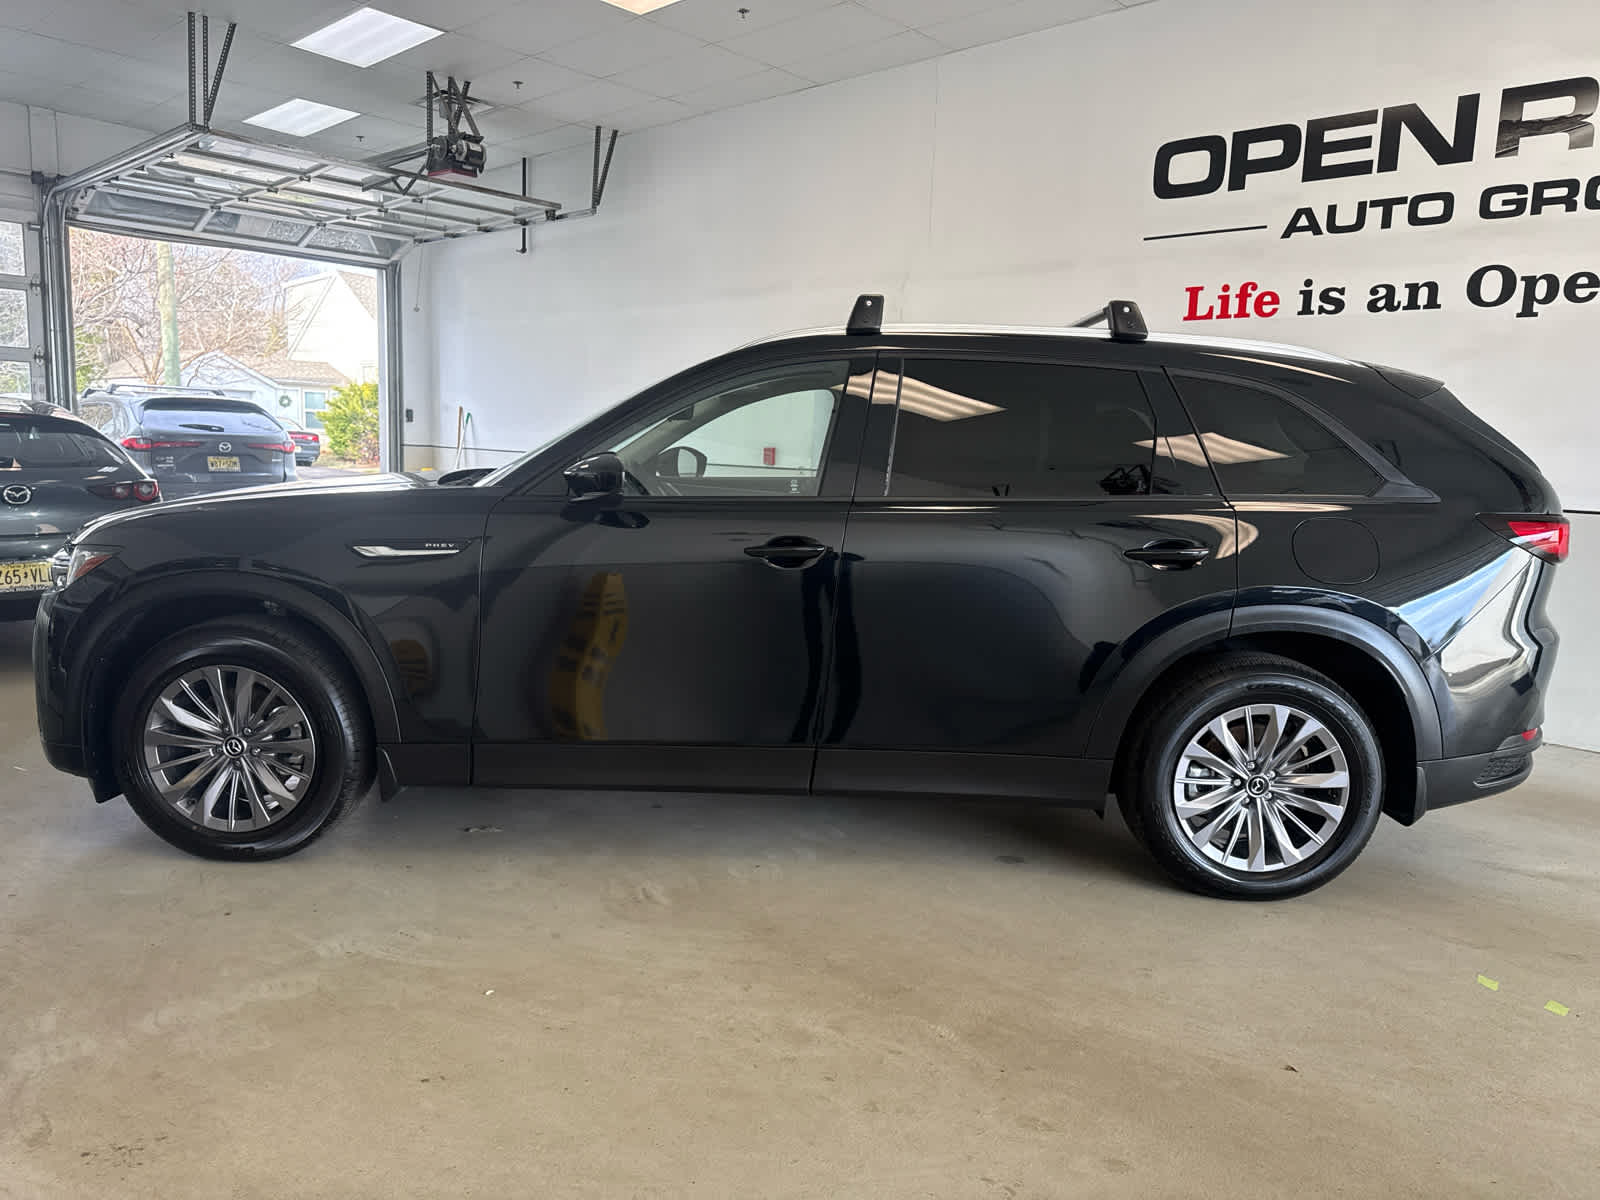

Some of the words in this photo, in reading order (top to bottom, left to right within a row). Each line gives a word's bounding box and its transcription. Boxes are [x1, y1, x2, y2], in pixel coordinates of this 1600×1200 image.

[1153, 92, 1480, 199] OPEN
[1280, 191, 1455, 239] AUTO
[1183, 281, 1280, 321] Life
[1297, 279, 1346, 316] is
[1367, 280, 1442, 314] an
[1466, 264, 1600, 318] Ope
